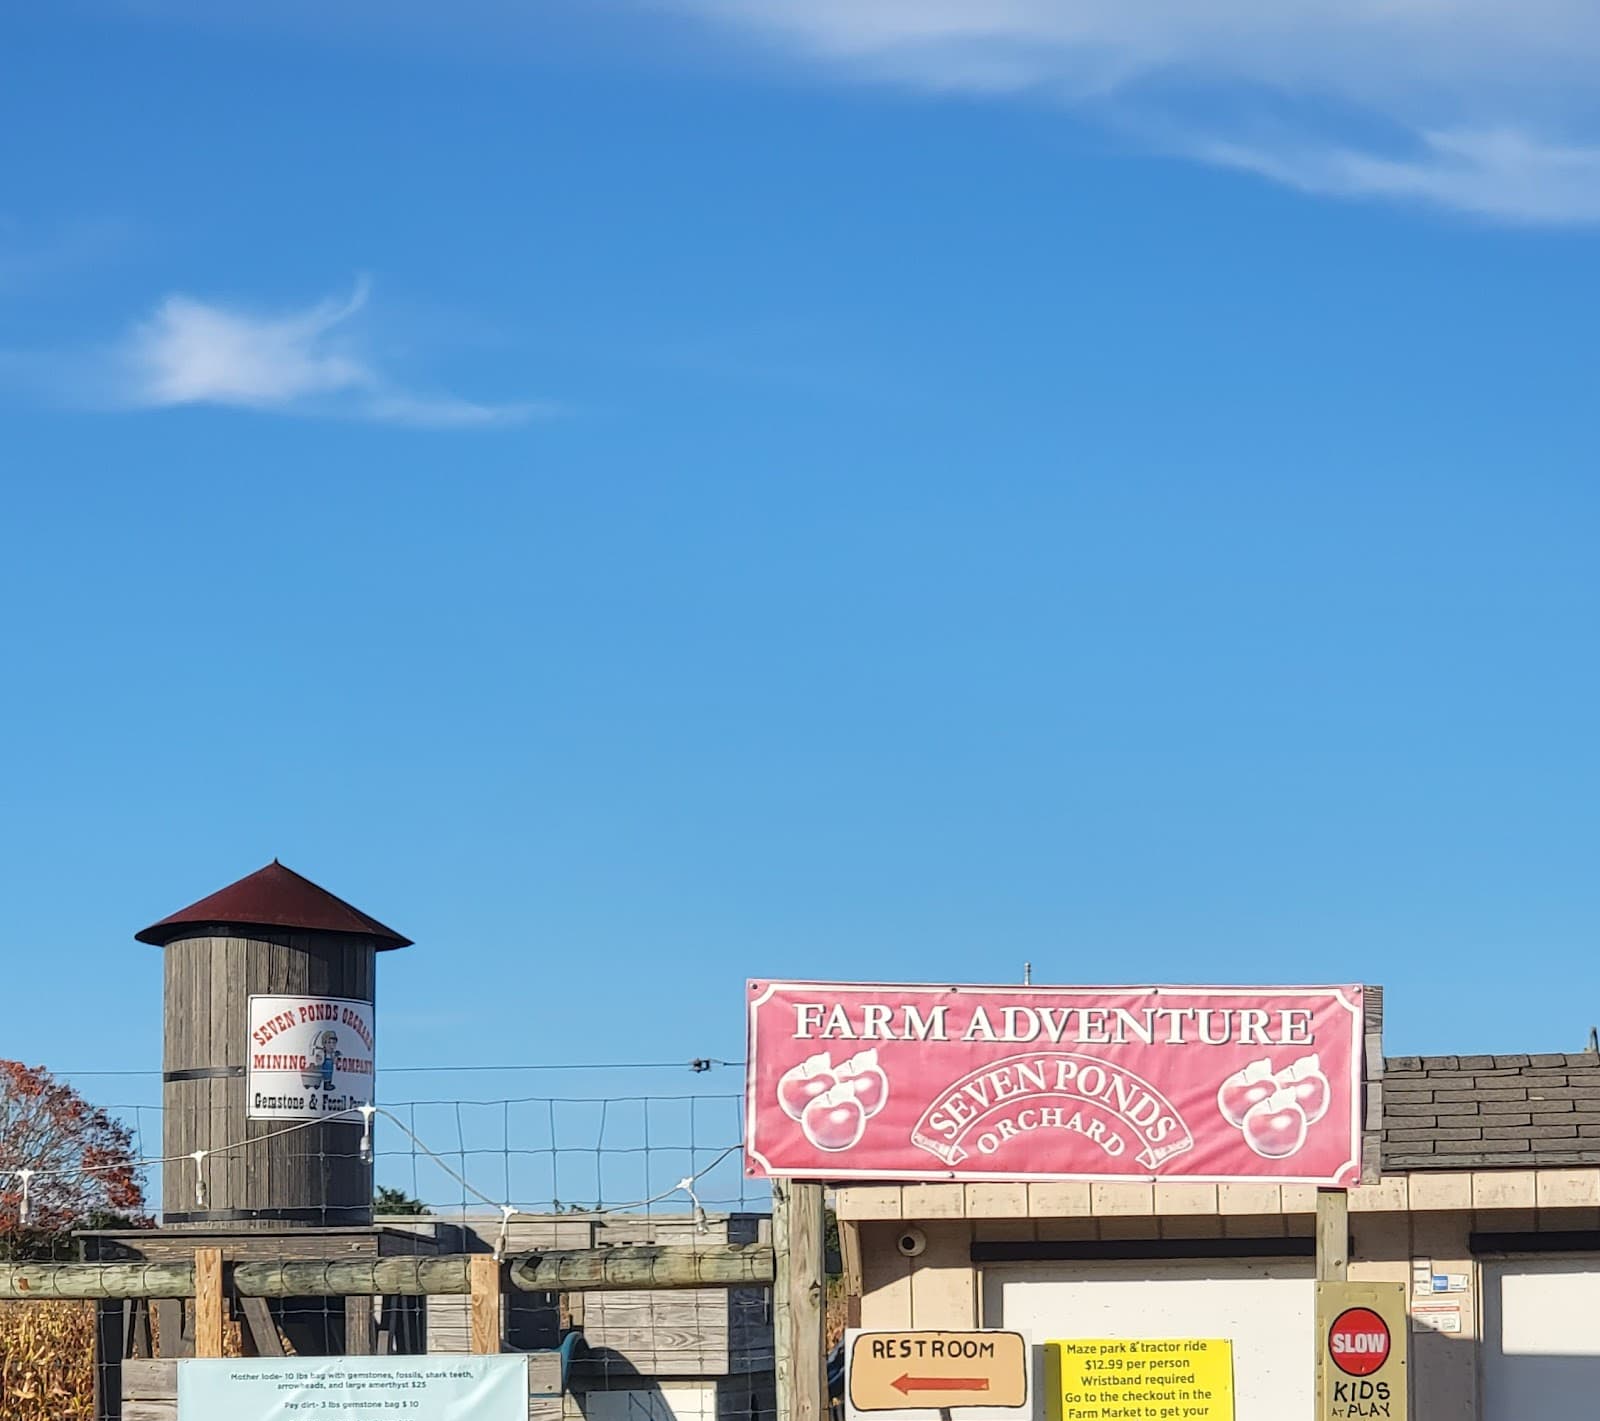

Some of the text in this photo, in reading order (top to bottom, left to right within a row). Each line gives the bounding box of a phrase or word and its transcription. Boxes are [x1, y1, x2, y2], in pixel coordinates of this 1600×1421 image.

[253, 1011, 296, 1047] SEVEN
[299, 1004, 338, 1023] PONDS
[792, 1004, 1314, 1046] FARM ADVENTURE
[254, 1054, 307, 1070] MINING
[255, 1093, 304, 1110] Gemstone
[309, 1094, 318, 1110] &
[929, 1060, 1176, 1142] SEVEN PONDS
[976, 1106, 1125, 1157] ORCHARD
[1067, 1341, 1207, 1355] Maze park & tractor ride
[1332, 1333, 1386, 1354] SLOW
[1085, 1359, 1190, 1370] $12.99 per person
[1081, 1373, 1195, 1387] Wristband required
[1065, 1389, 1212, 1403] Go to the checkout in the
[1334, 1381, 1390, 1402] KIDS
[1069, 1406, 1209, 1419] Farm Market to get your
[1331, 1401, 1390, 1418] AT PLAY
